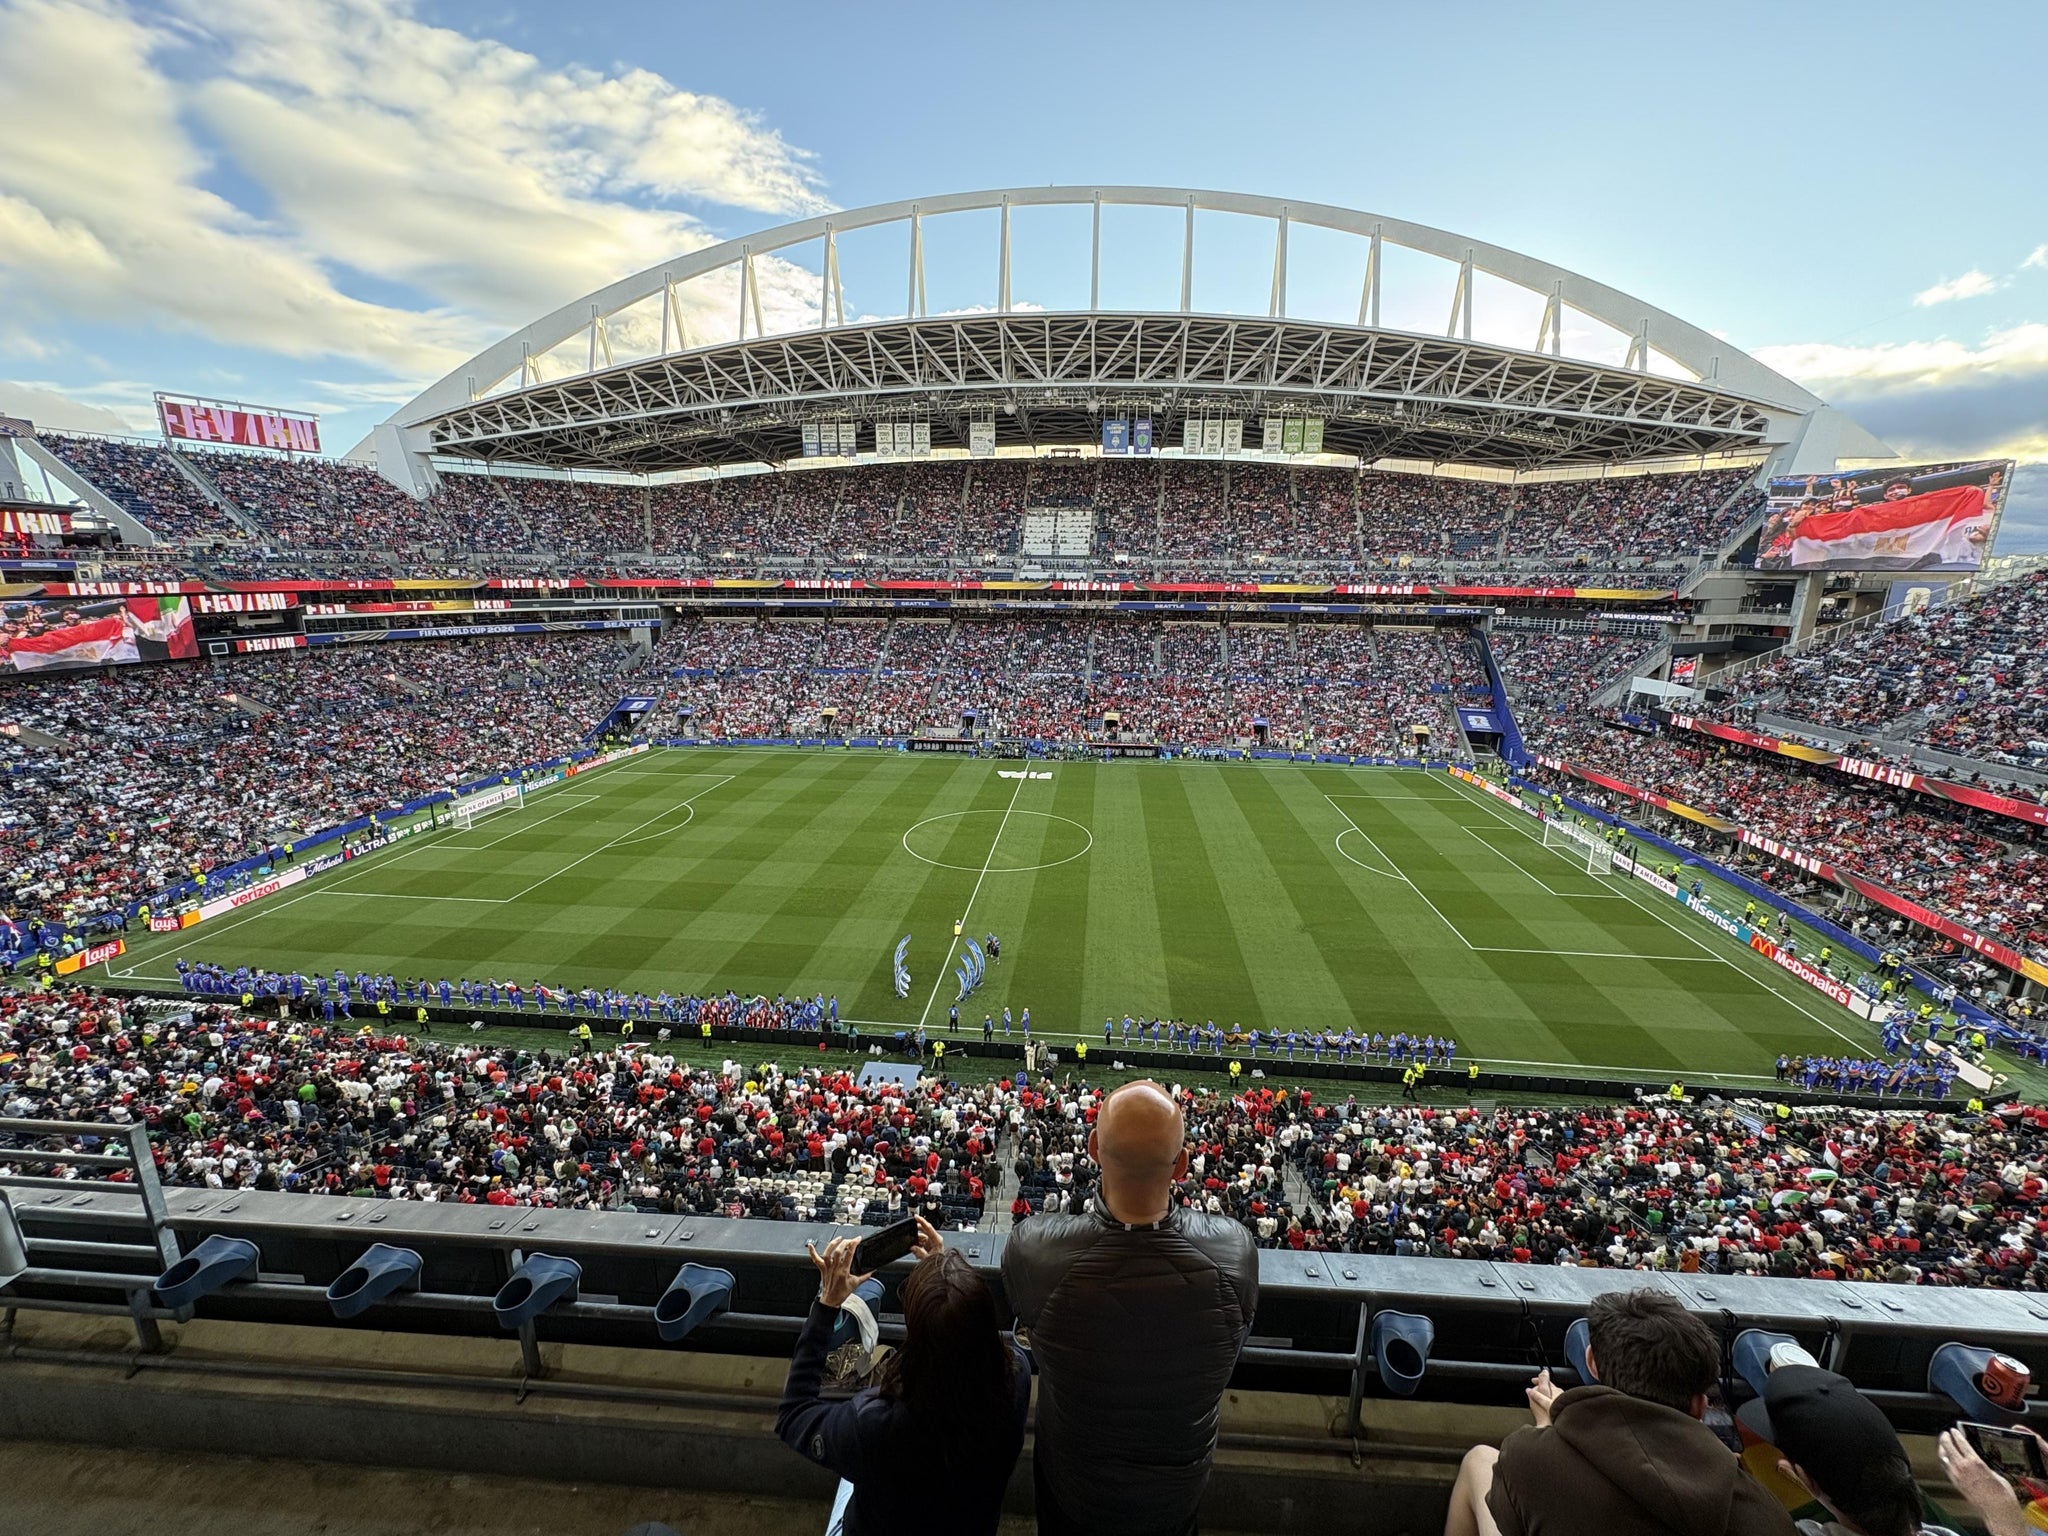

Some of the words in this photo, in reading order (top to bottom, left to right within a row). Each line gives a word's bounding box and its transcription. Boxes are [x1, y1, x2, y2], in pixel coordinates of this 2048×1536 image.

[440, 628, 469, 636] WORLD
[524, 774, 560, 792] Hisense
[486, 793, 511, 806] AMERCA
[306, 853, 344, 877] Michelob
[353, 837, 388, 857] ULTRA
[1614, 855, 1631, 869] BANK
[1640, 869, 1669, 890] AMERICA
[231, 880, 281, 907] verizon
[151, 917, 178, 931] Lay's
[1685, 894, 1739, 936] Hisense
[85, 943, 118, 967] Lay's
[1773, 949, 1848, 1004] McDonald's
